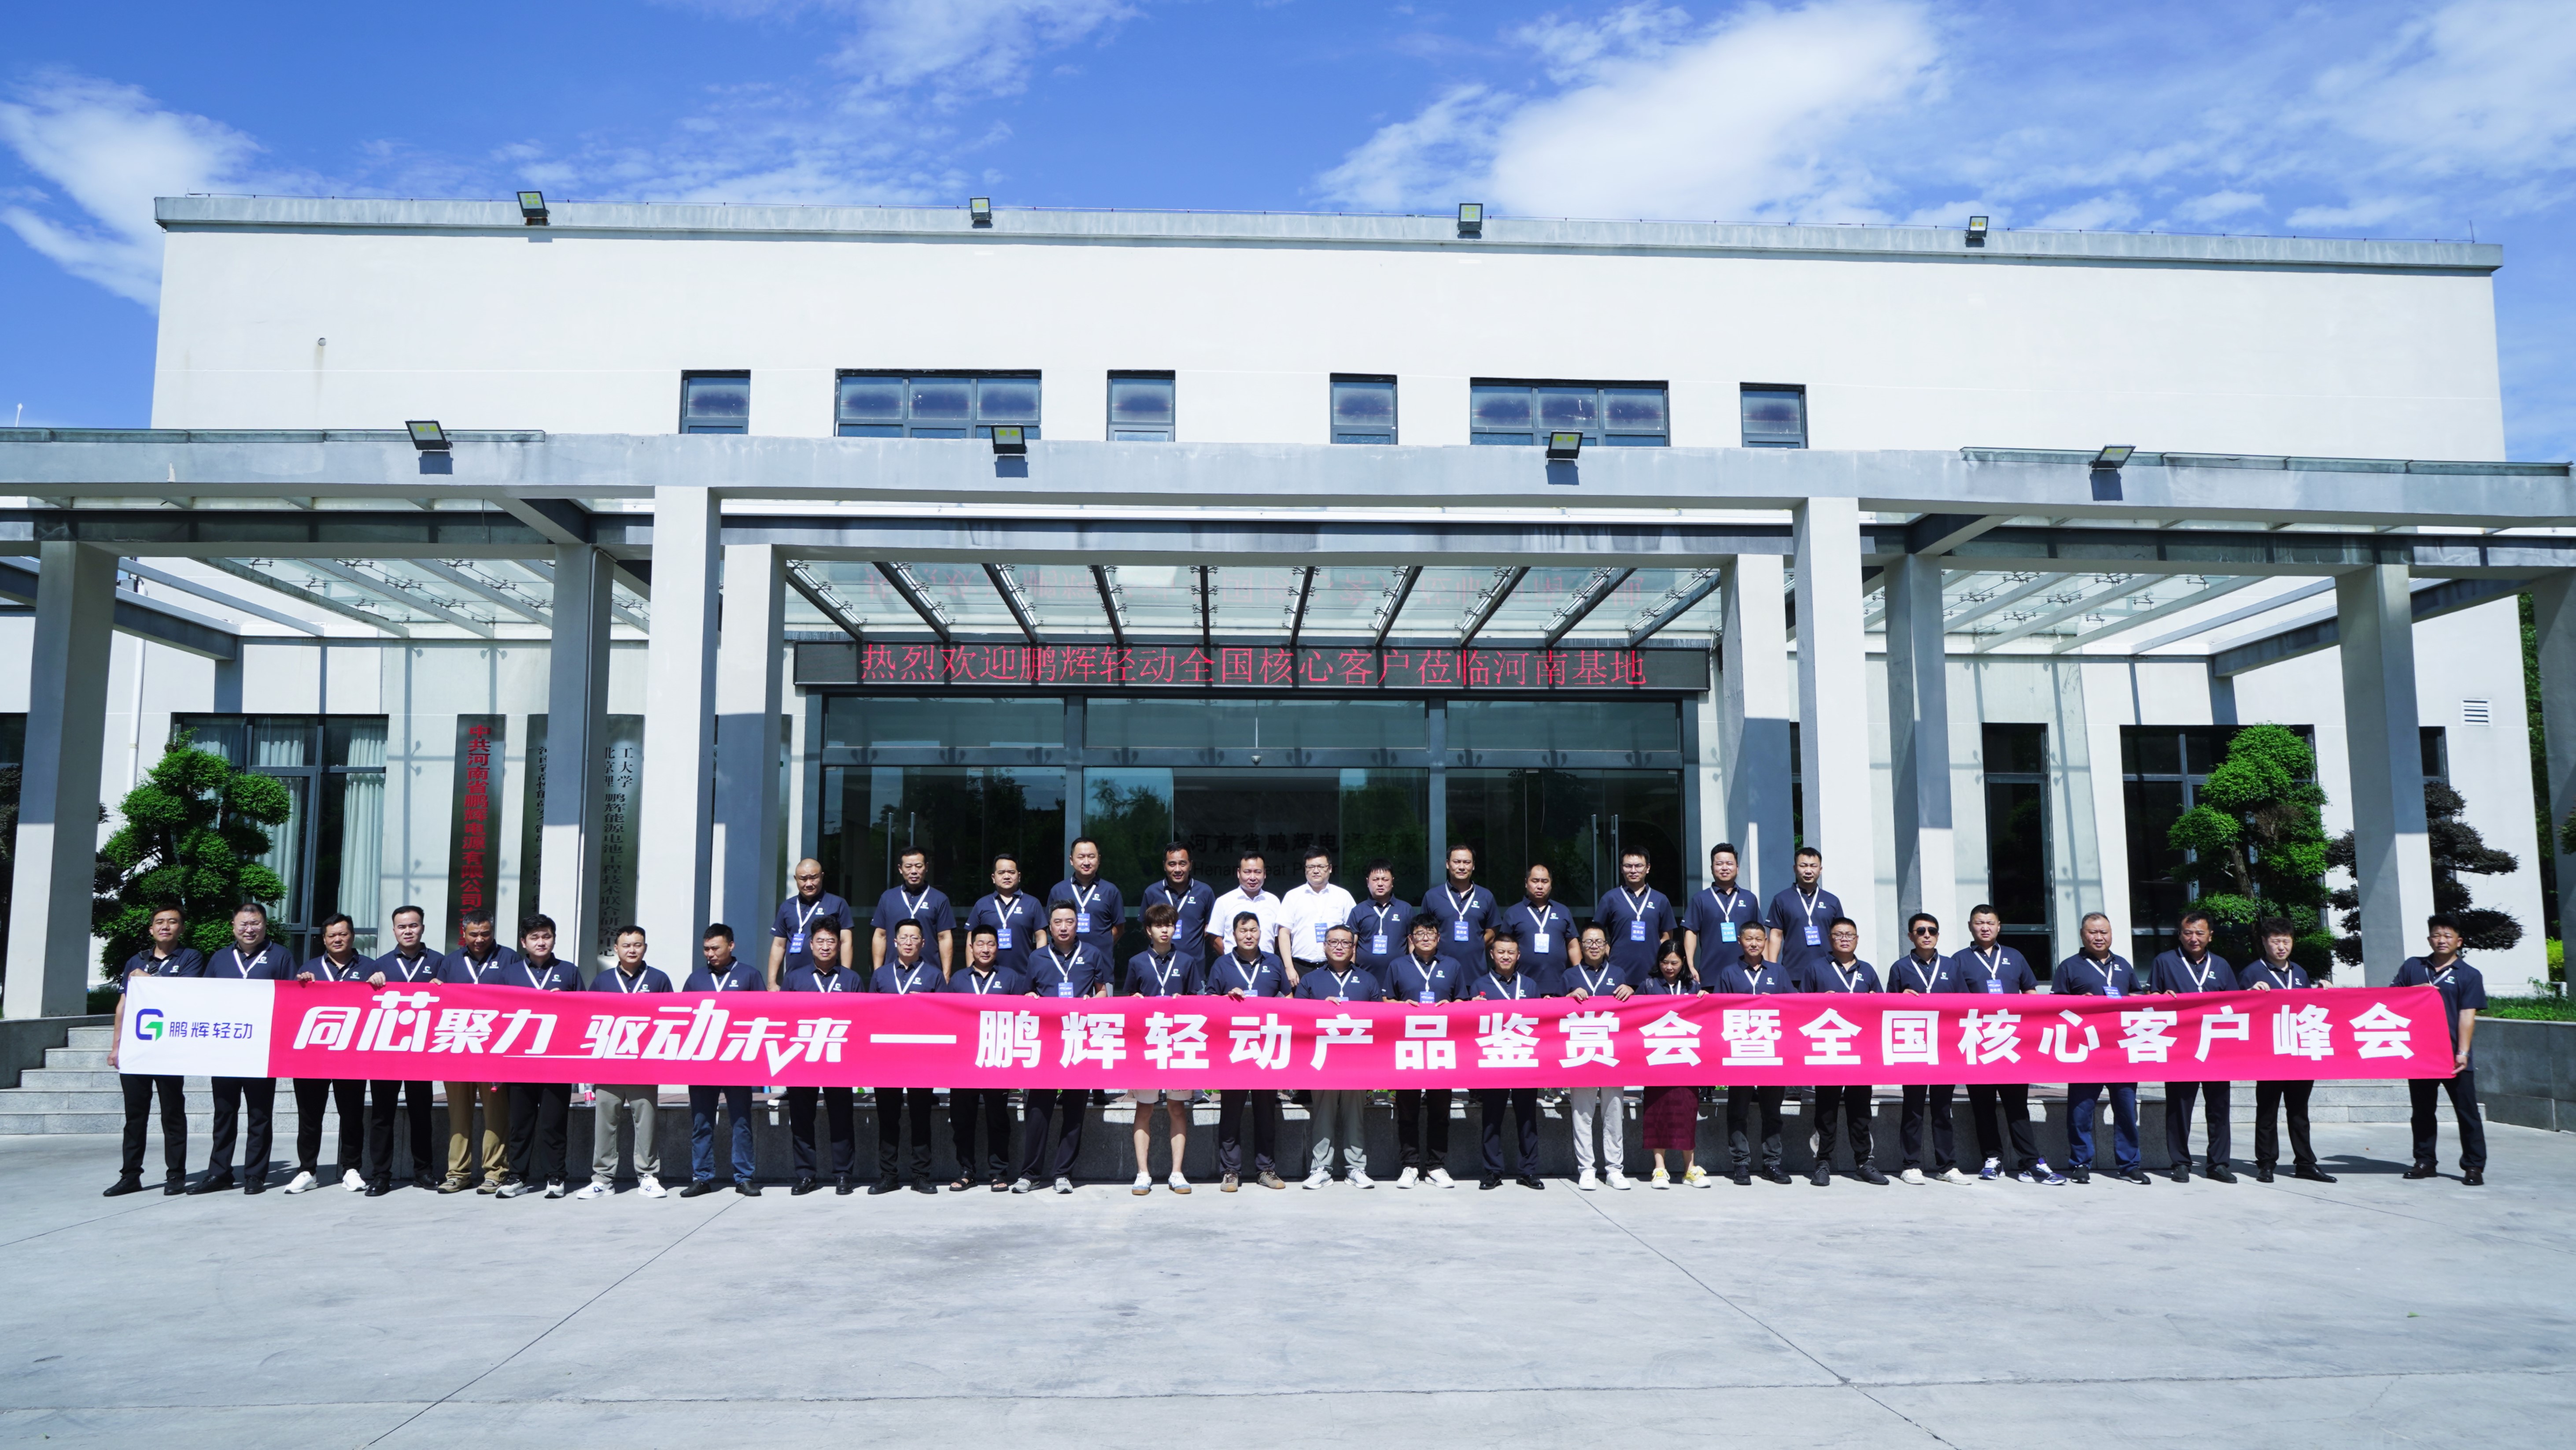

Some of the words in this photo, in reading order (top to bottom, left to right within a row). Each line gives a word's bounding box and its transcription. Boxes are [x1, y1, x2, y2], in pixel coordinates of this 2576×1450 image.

[860, 644, 1646, 685] 热烈欢迎鹏辉轻动全国核心客户莅临河南基地
[458, 725, 491, 947] 中共河南省鹏辉电源有限公司
[170, 1021, 252, 1039] 鹏辉轻动
[293, 991, 557, 1058] 同芯聚力
[580, 999, 852, 1076] 驱动未来
[974, 1002, 2414, 1071] 鹏辉轻动产品鉴赏会暨全国核心客户峰会
